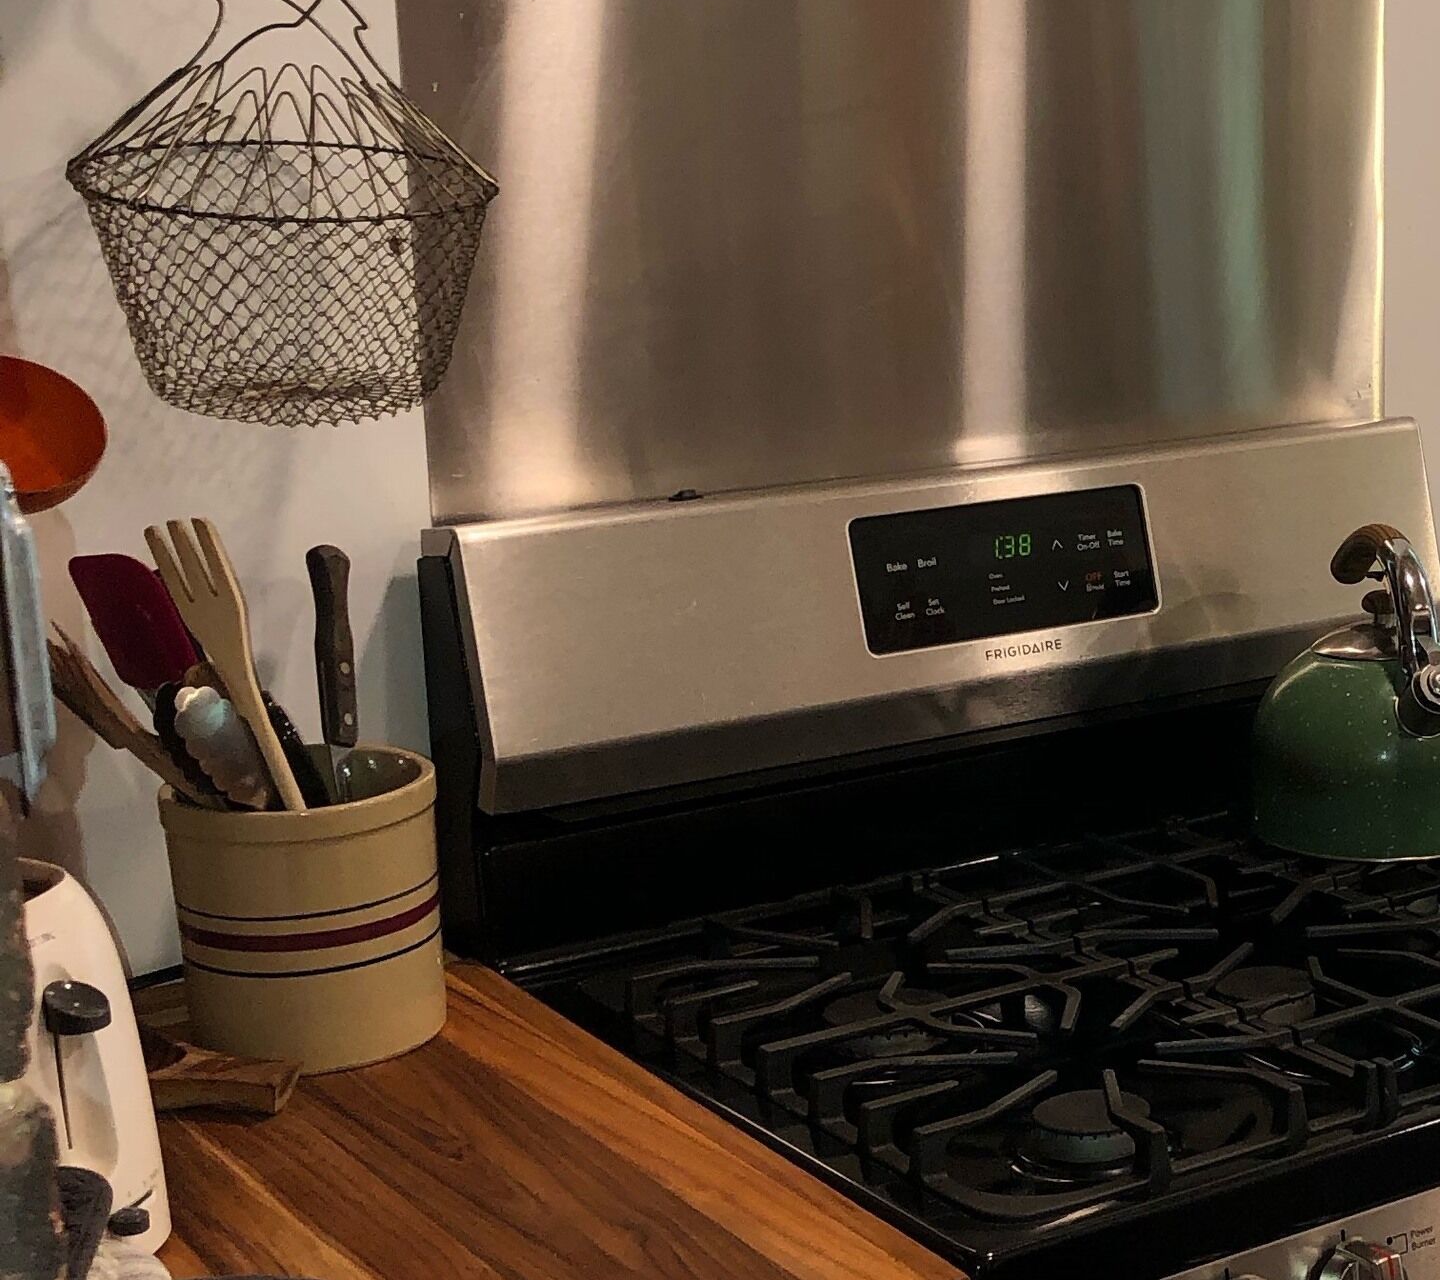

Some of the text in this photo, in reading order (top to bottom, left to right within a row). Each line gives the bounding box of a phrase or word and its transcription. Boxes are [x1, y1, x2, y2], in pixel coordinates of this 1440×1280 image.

[995, 533, 1031, 560] 1:38
[1076, 540, 1100, 551] On-Off
[886, 561, 908, 572] Bake
[917, 556, 937, 568] Broil
[896, 601, 911, 611] Self
[927, 598, 940, 606] Set
[895, 612, 916, 621] Clean
[925, 606, 945, 616] Clock
[985, 638, 1063, 661] FRIGIDAIRE
[1410, 1226, 1434, 1238] Power
[1411, 1237, 1436, 1251] Burner
